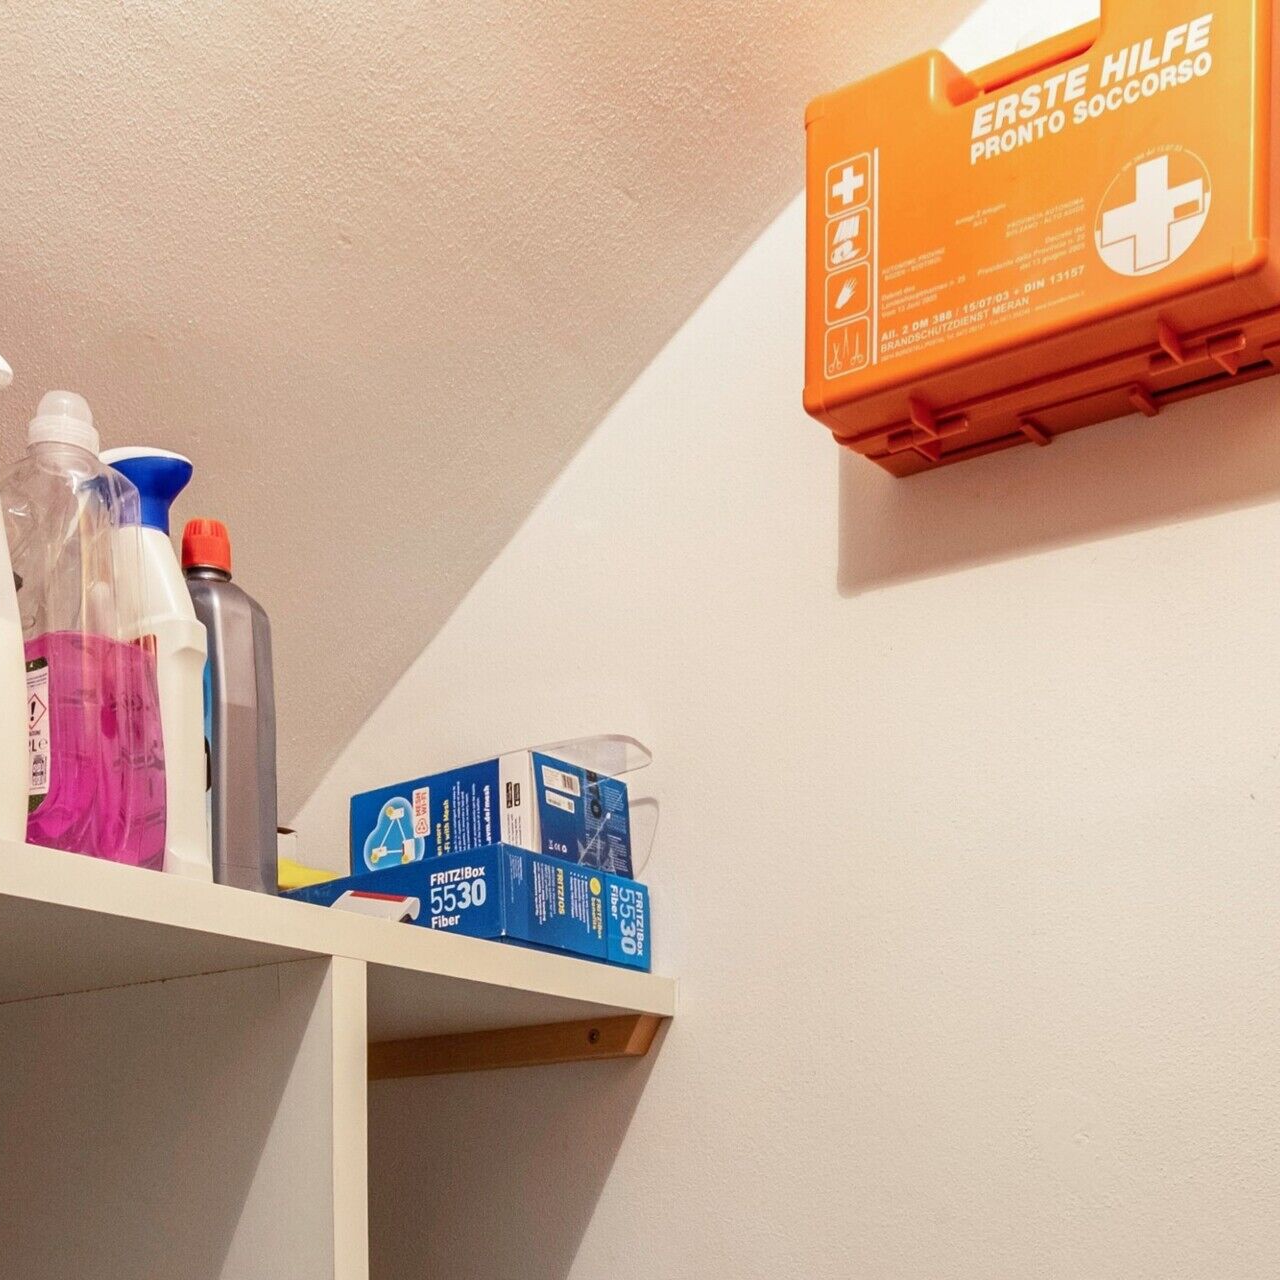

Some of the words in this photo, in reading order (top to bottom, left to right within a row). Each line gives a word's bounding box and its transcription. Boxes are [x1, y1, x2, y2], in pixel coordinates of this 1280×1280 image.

[971, 63, 1090, 139] ERSTE
[1100, 13, 1213, 88] HILFE
[970, 110, 1065, 165] PRONTO
[1073, 52, 1212, 124] SOCCORSO
[880, 309, 989, 353] BRANDSCHUTZDIENST
[992, 297, 1030, 315] MERAN
[902, 325, 909, 335] 2
[912, 319, 929, 331] DM
[962, 291, 1009, 314] 15/07/03
[1024, 278, 1045, 294] DIN
[1050, 264, 1085, 284] 13157
[430, 866, 486, 887] FRITZ!Box
[430, 878, 487, 914] 5530
[610, 884, 618, 920] Fiber
[431, 914, 460, 929] Fiber
[619, 887, 636, 955] 5530
[636, 890, 644, 956] FRITZ!Box
